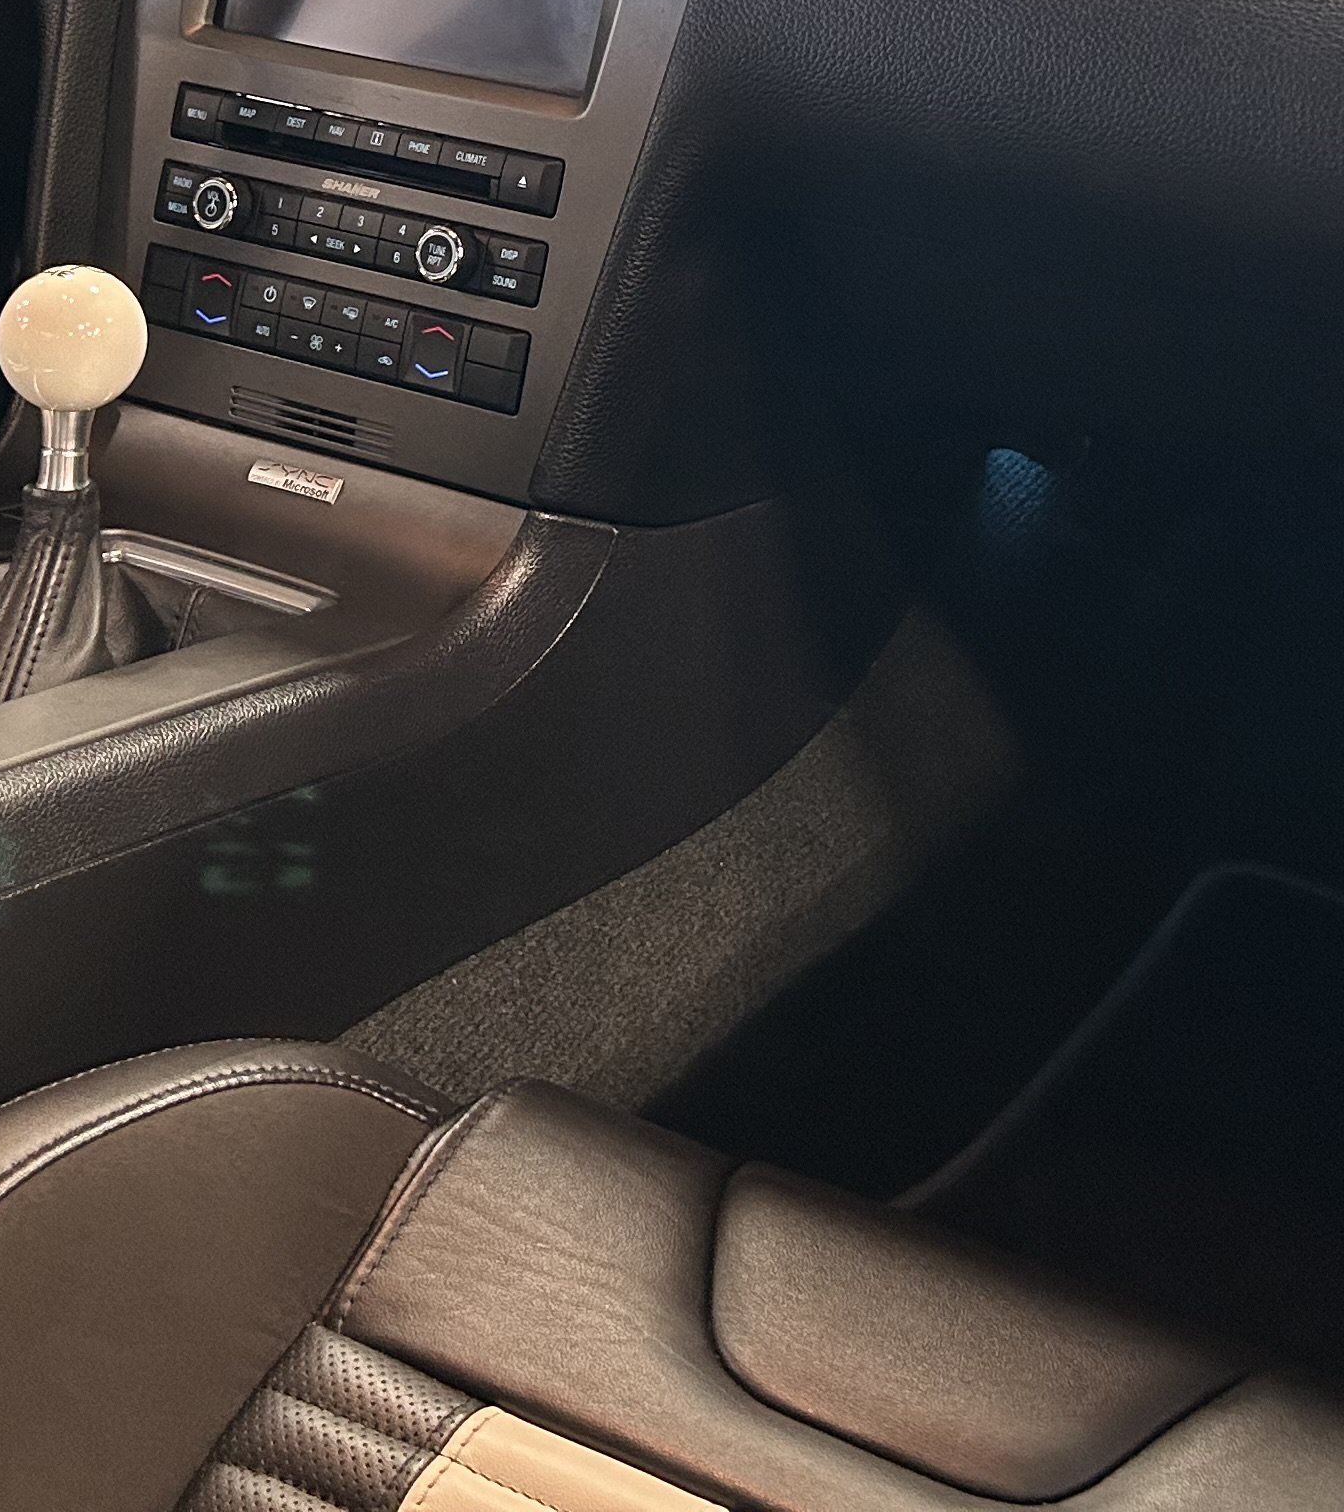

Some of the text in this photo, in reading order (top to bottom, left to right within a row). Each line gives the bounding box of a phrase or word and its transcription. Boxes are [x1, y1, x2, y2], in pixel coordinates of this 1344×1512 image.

[239, 107, 257, 118] MAP
[286, 116, 307, 128] DEST
[328, 125, 346, 137] NAV
[408, 141, 431, 155] PHONE
[456, 151, 488, 167] CLIMATE
[278, 197, 284, 209] 1
[316, 206, 325, 218] 2
[357, 215, 365, 227] 3
[271, 224, 279, 236] 5
[399, 224, 407, 236] 4
[325, 237, 345, 250] SEEK
[428, 243, 447, 257] TUNE
[500, 248, 519, 261] DISP
[393, 251, 401, 264] 6
[492, 274, 517, 289] SOUND
[384, 317, 399, 329] A/C
[281, 478, 330, 500] Microsoft
